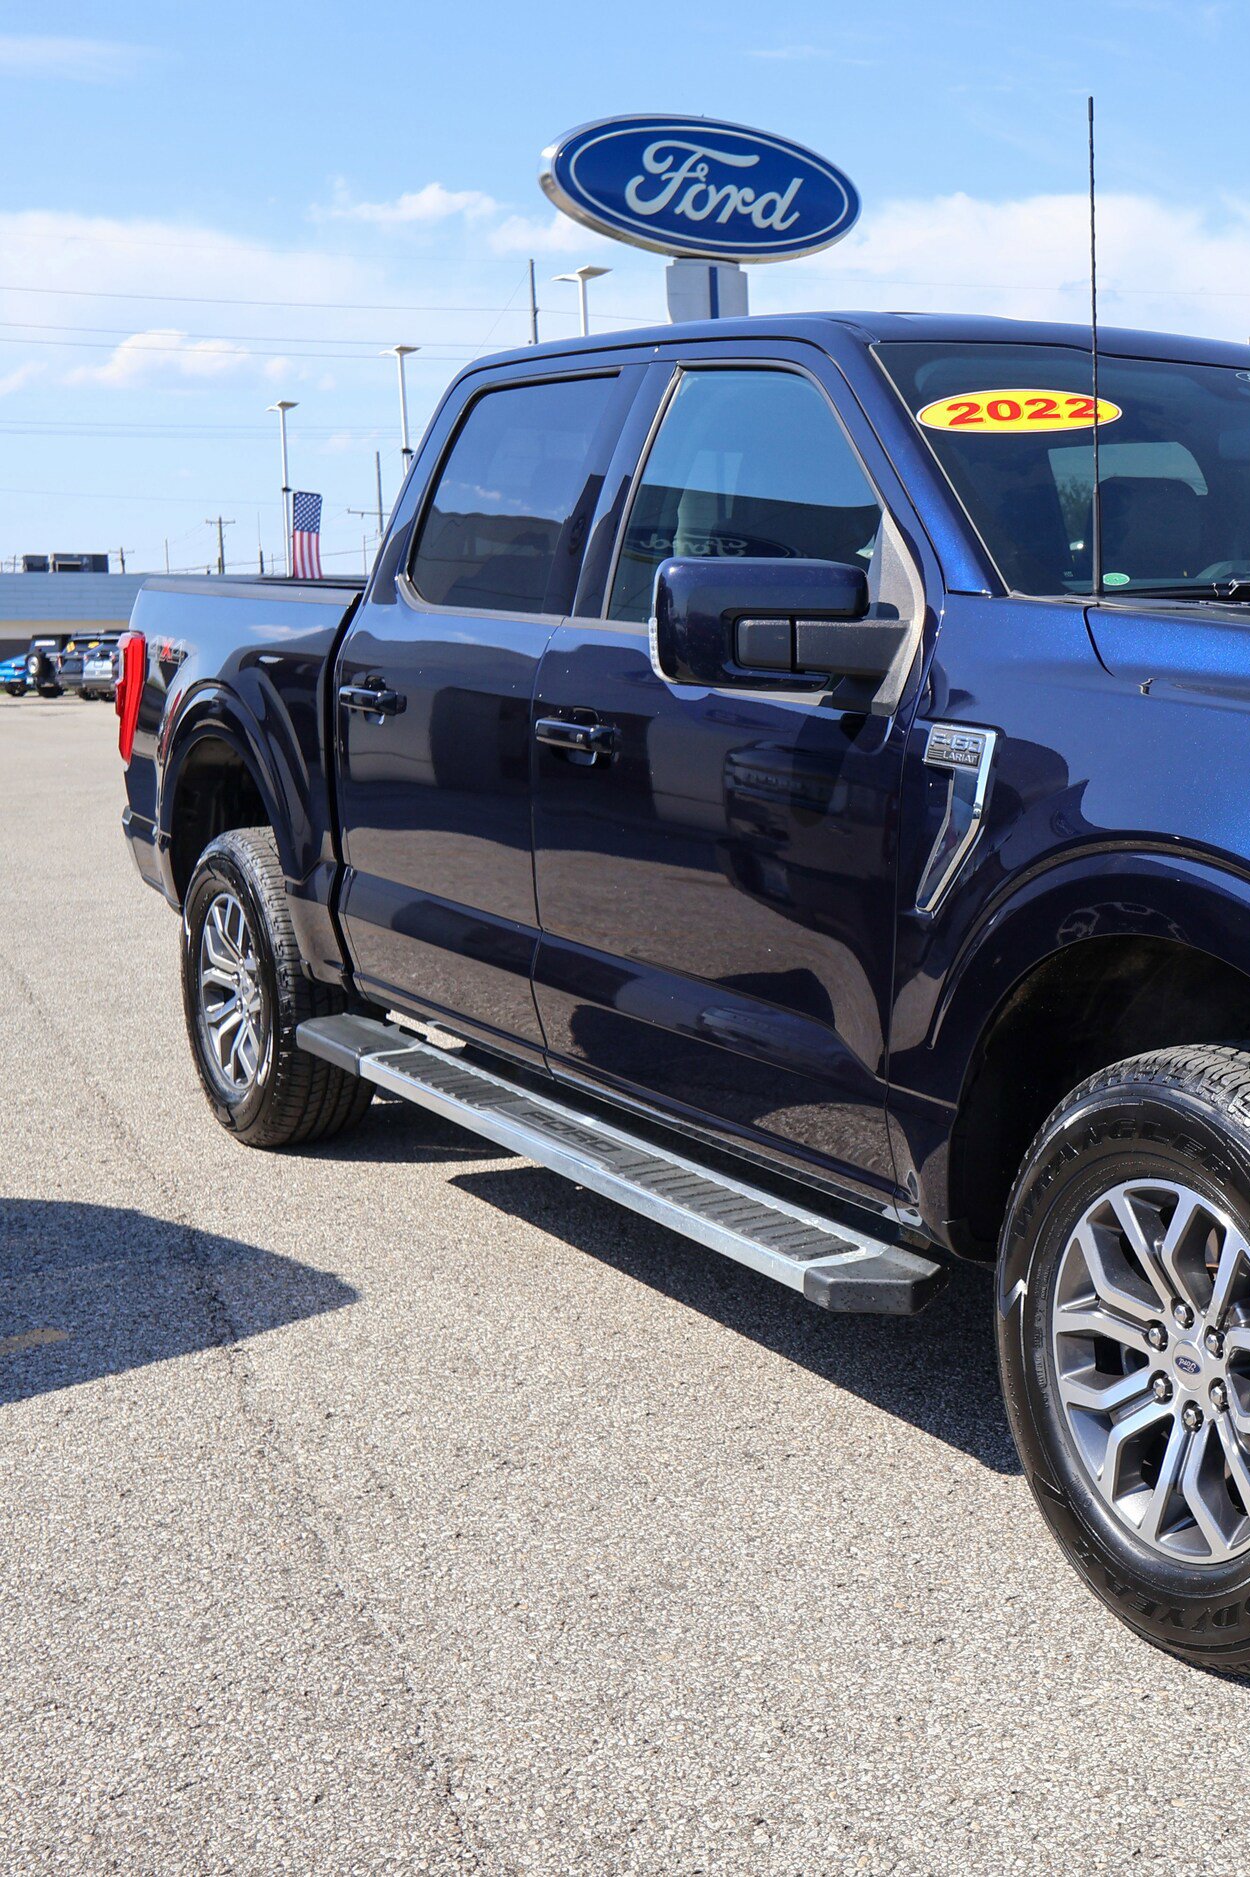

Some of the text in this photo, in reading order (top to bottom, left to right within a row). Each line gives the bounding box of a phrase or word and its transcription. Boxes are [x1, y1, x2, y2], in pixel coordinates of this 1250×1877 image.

[624, 139, 804, 232] Ford
[946, 397, 1101, 426] 2022
[942, 750, 977, 763] LARIAT
